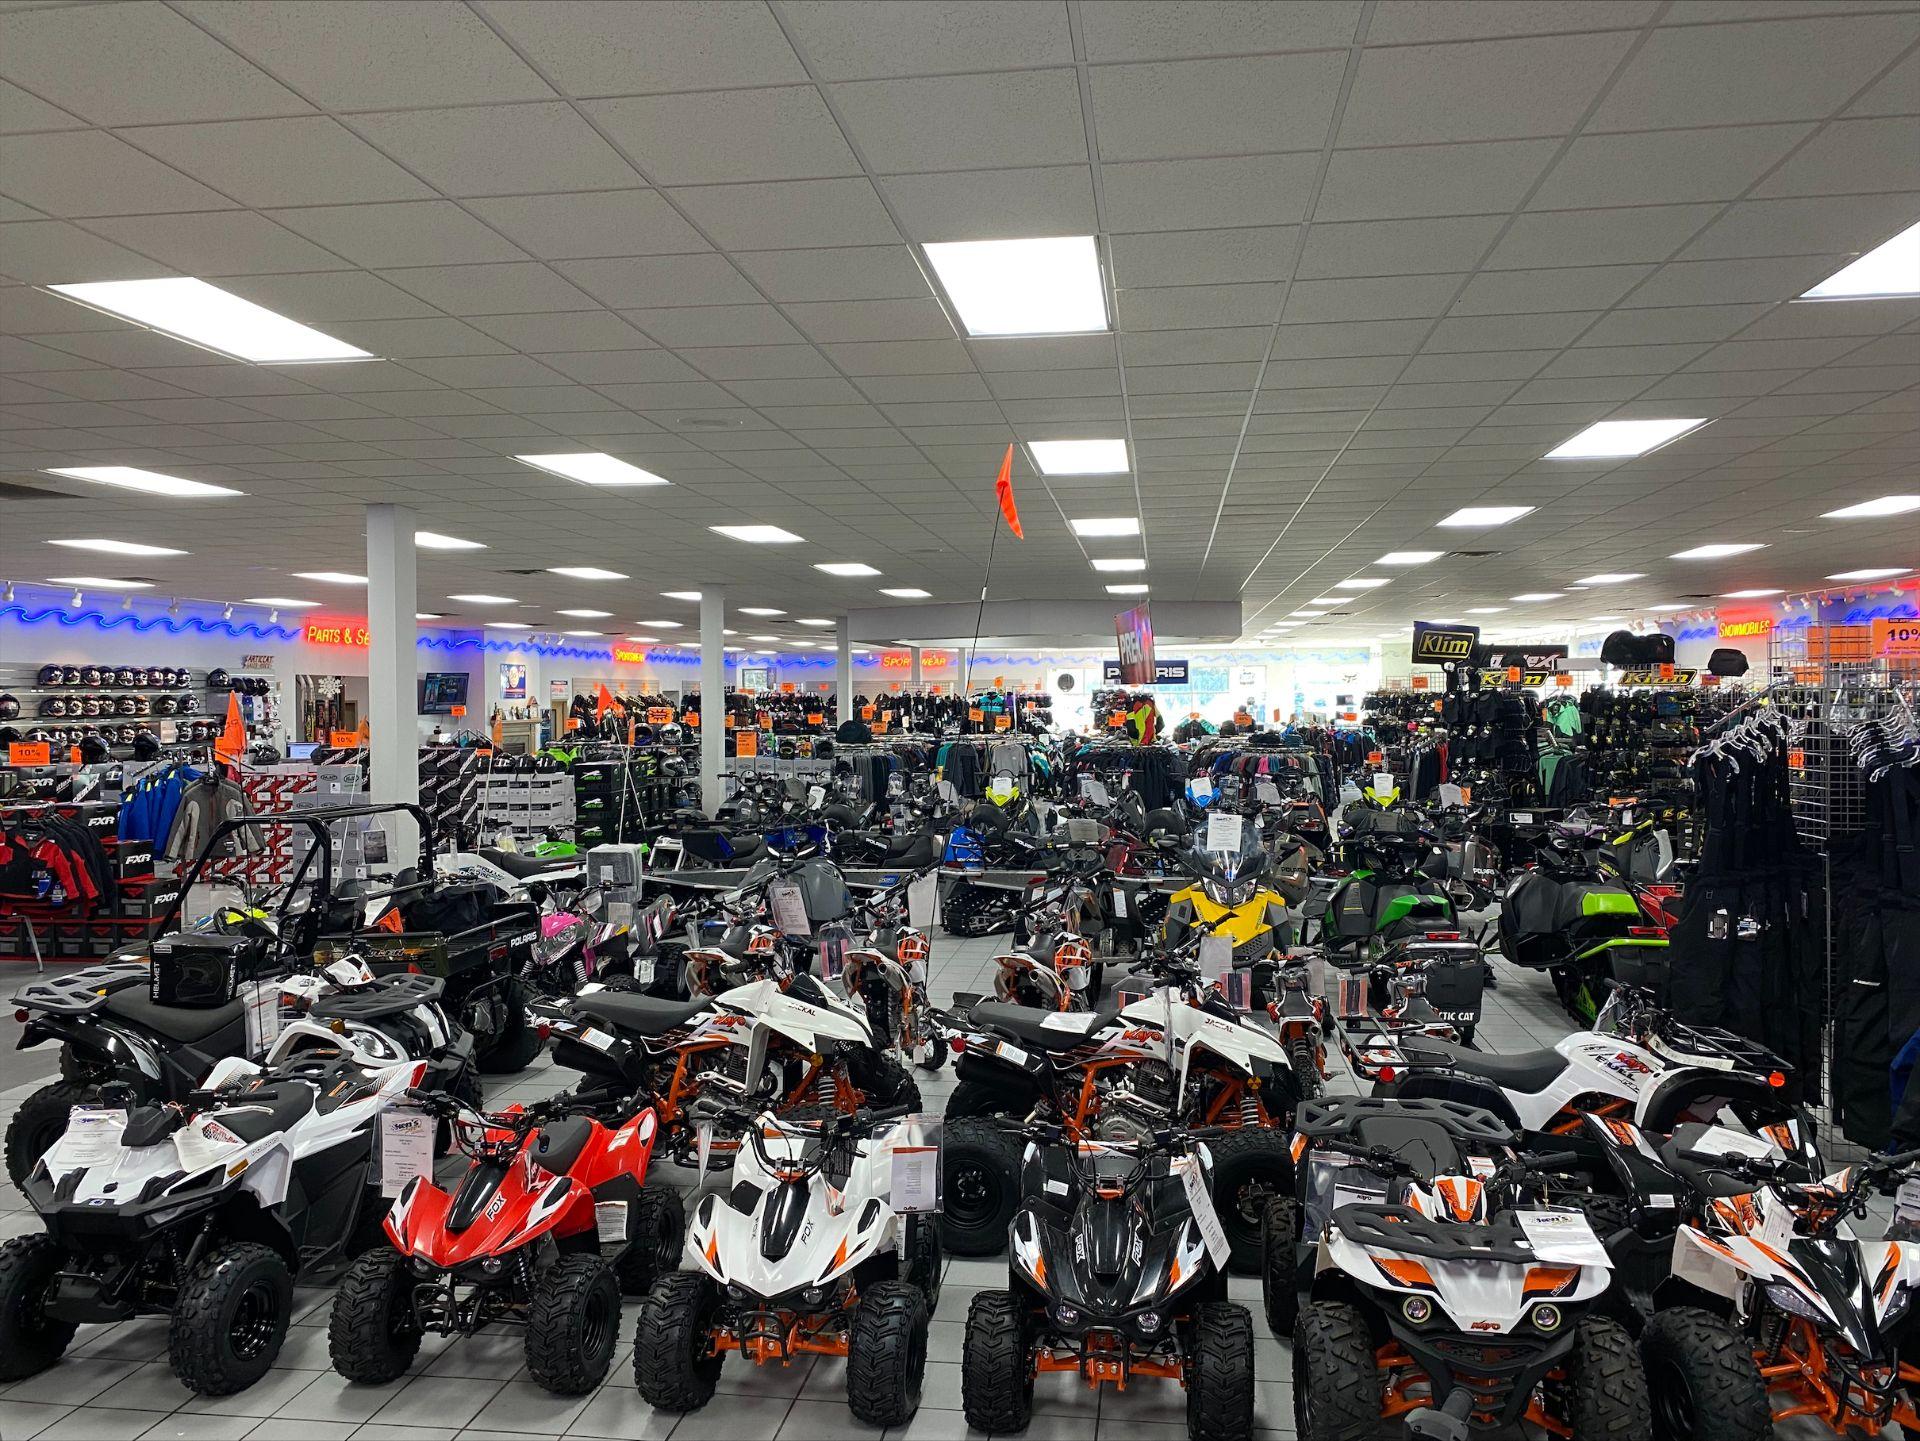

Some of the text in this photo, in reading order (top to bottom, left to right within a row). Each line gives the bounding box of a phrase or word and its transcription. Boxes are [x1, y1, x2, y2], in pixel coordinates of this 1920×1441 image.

[307, 626, 340, 643] PARTS
[344, 628, 353, 644] &
[1719, 620, 1770, 638] SNOWMOBILES
[88, 816, 115, 827] FXR
[125, 853, 151, 865] FXR
[154, 892, 179, 904] FXR
[510, 931, 537, 948] POLARIS
[227, 963, 236, 1000] HELMET
[1458, 1012, 1474, 1021] CAT
[486, 1193, 507, 1221] FOX
[801, 1218, 813, 1246] FOX
[1075, 1234, 1086, 1264] FOX
[1131, 1233, 1143, 1267] FOX
